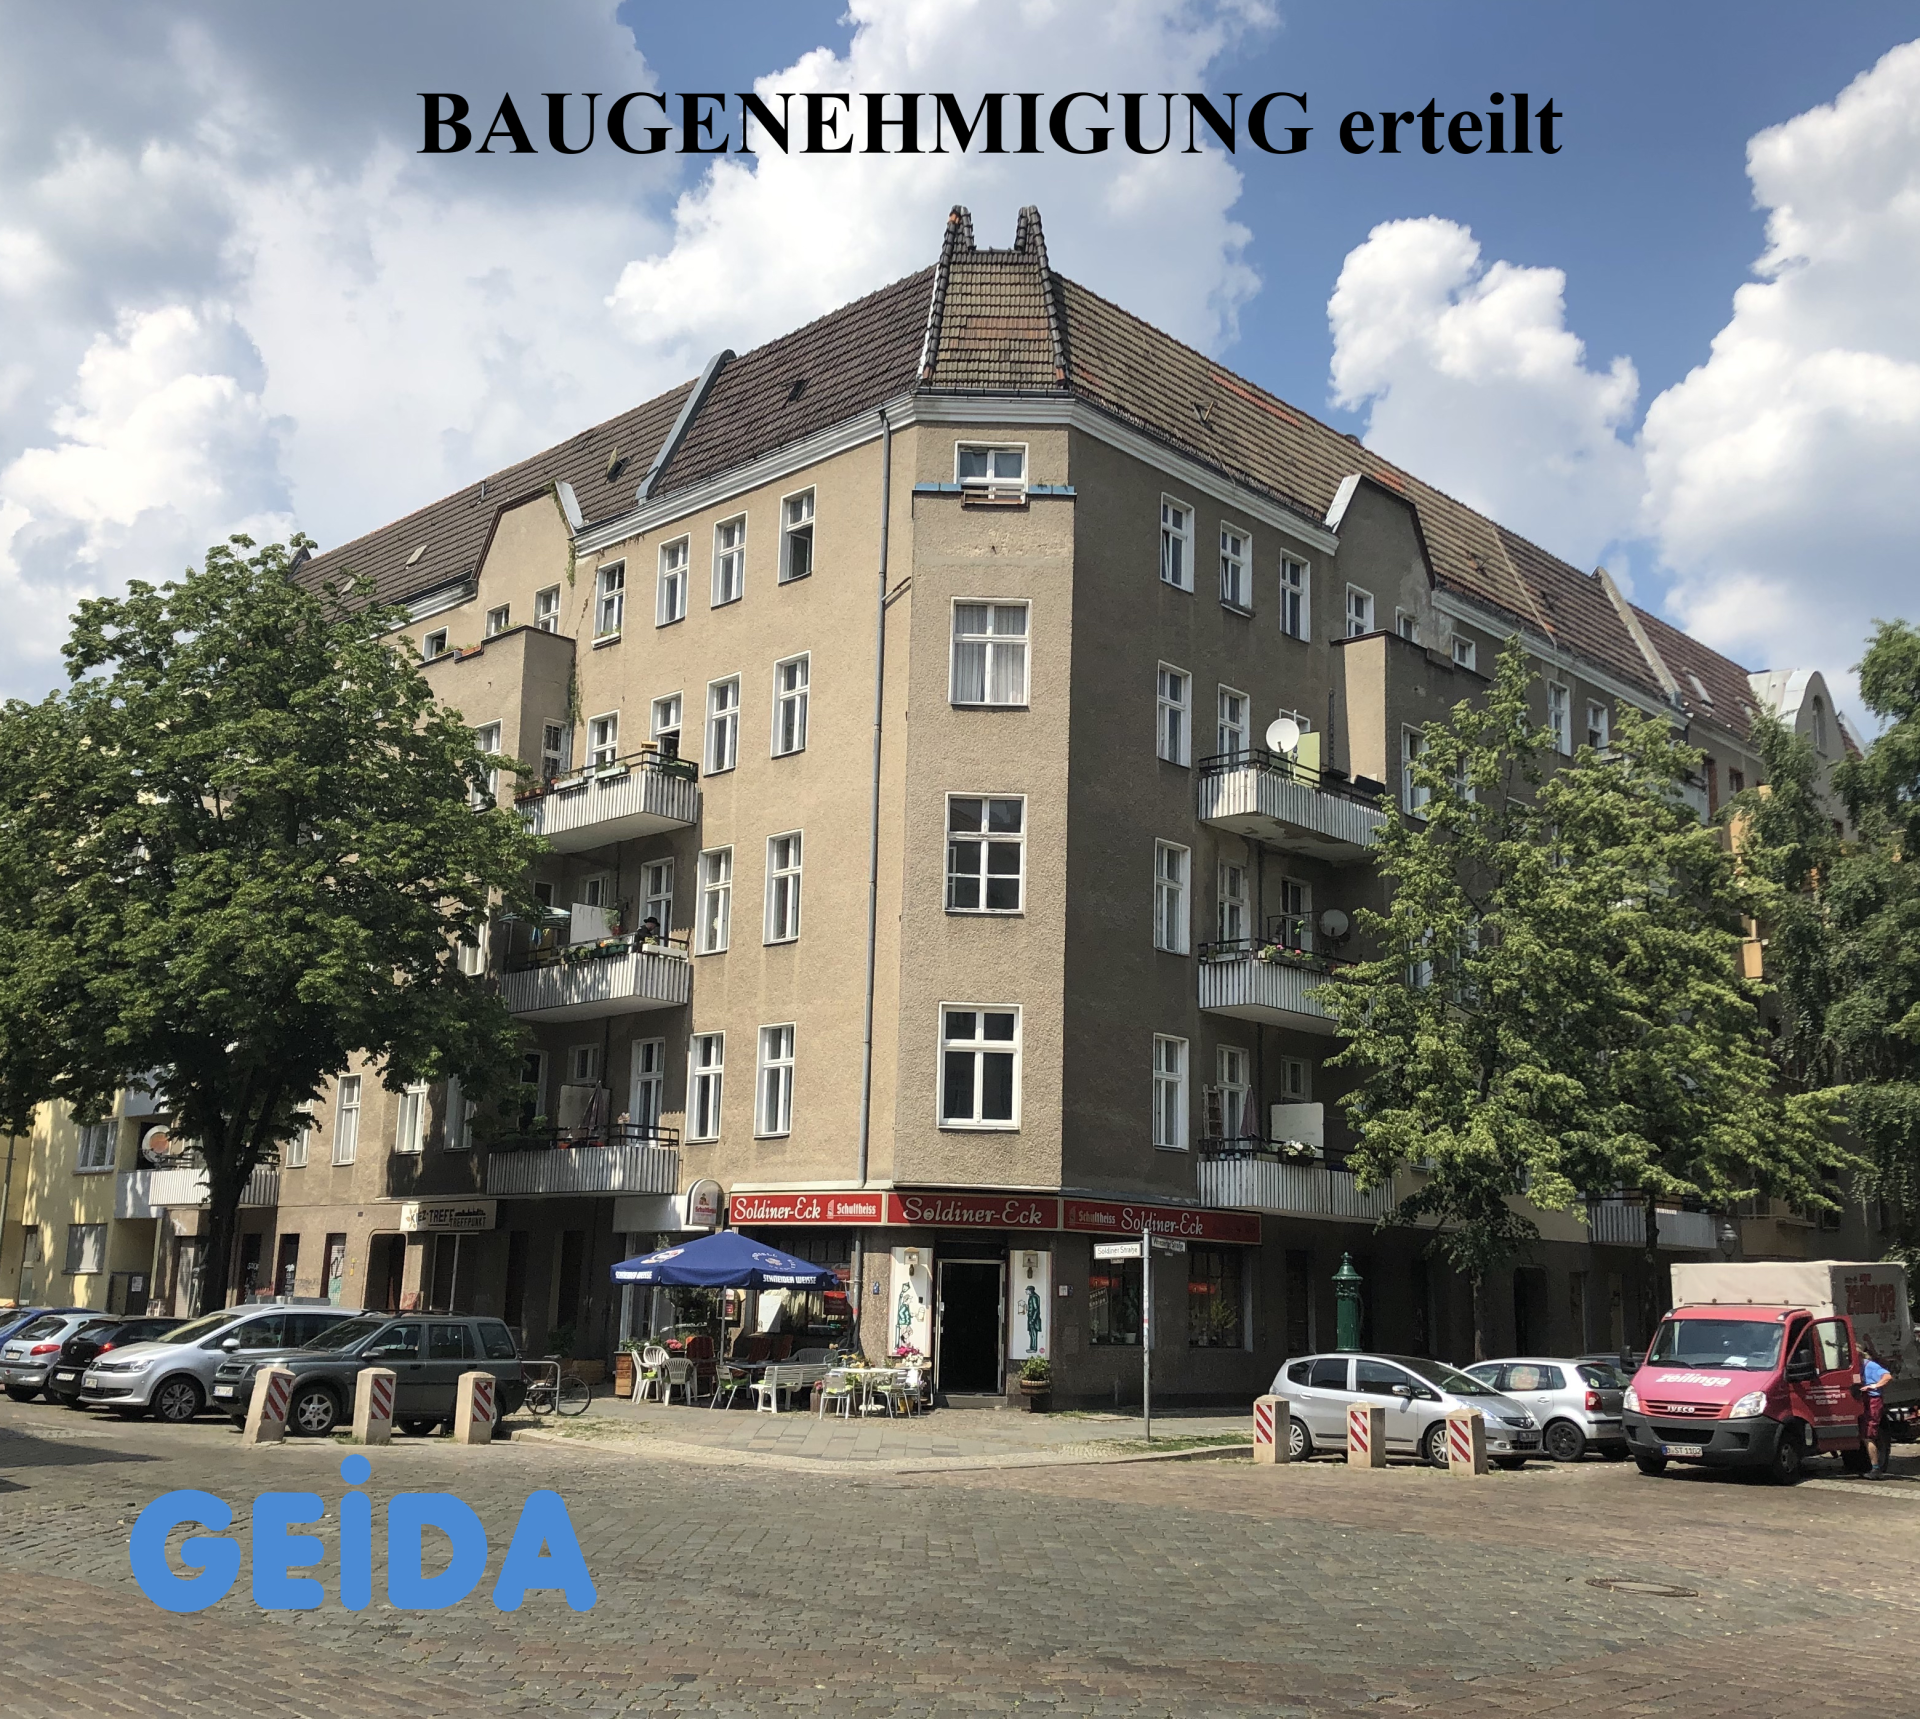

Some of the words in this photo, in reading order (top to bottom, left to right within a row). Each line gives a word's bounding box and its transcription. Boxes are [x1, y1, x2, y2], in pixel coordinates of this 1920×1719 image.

[734, 1197, 821, 1220] Soldiner-Eck
[836, 1202, 877, 1215] Schultheiss
[903, 1197, 1042, 1225] Soldiner-Eck
[1078, 1210, 1116, 1225] Schultheiss
[1121, 1207, 1203, 1235] Soldiner-Eck
[1097, 1246, 1119, 1255] Soldiner
[762, 1274, 794, 1283] SCHNEIDER
[796, 1275, 817, 1284] WEISSE
[1655, 1373, 1732, 1387] zeilinga
[1667, 1405, 1695, 1413] IVECO
